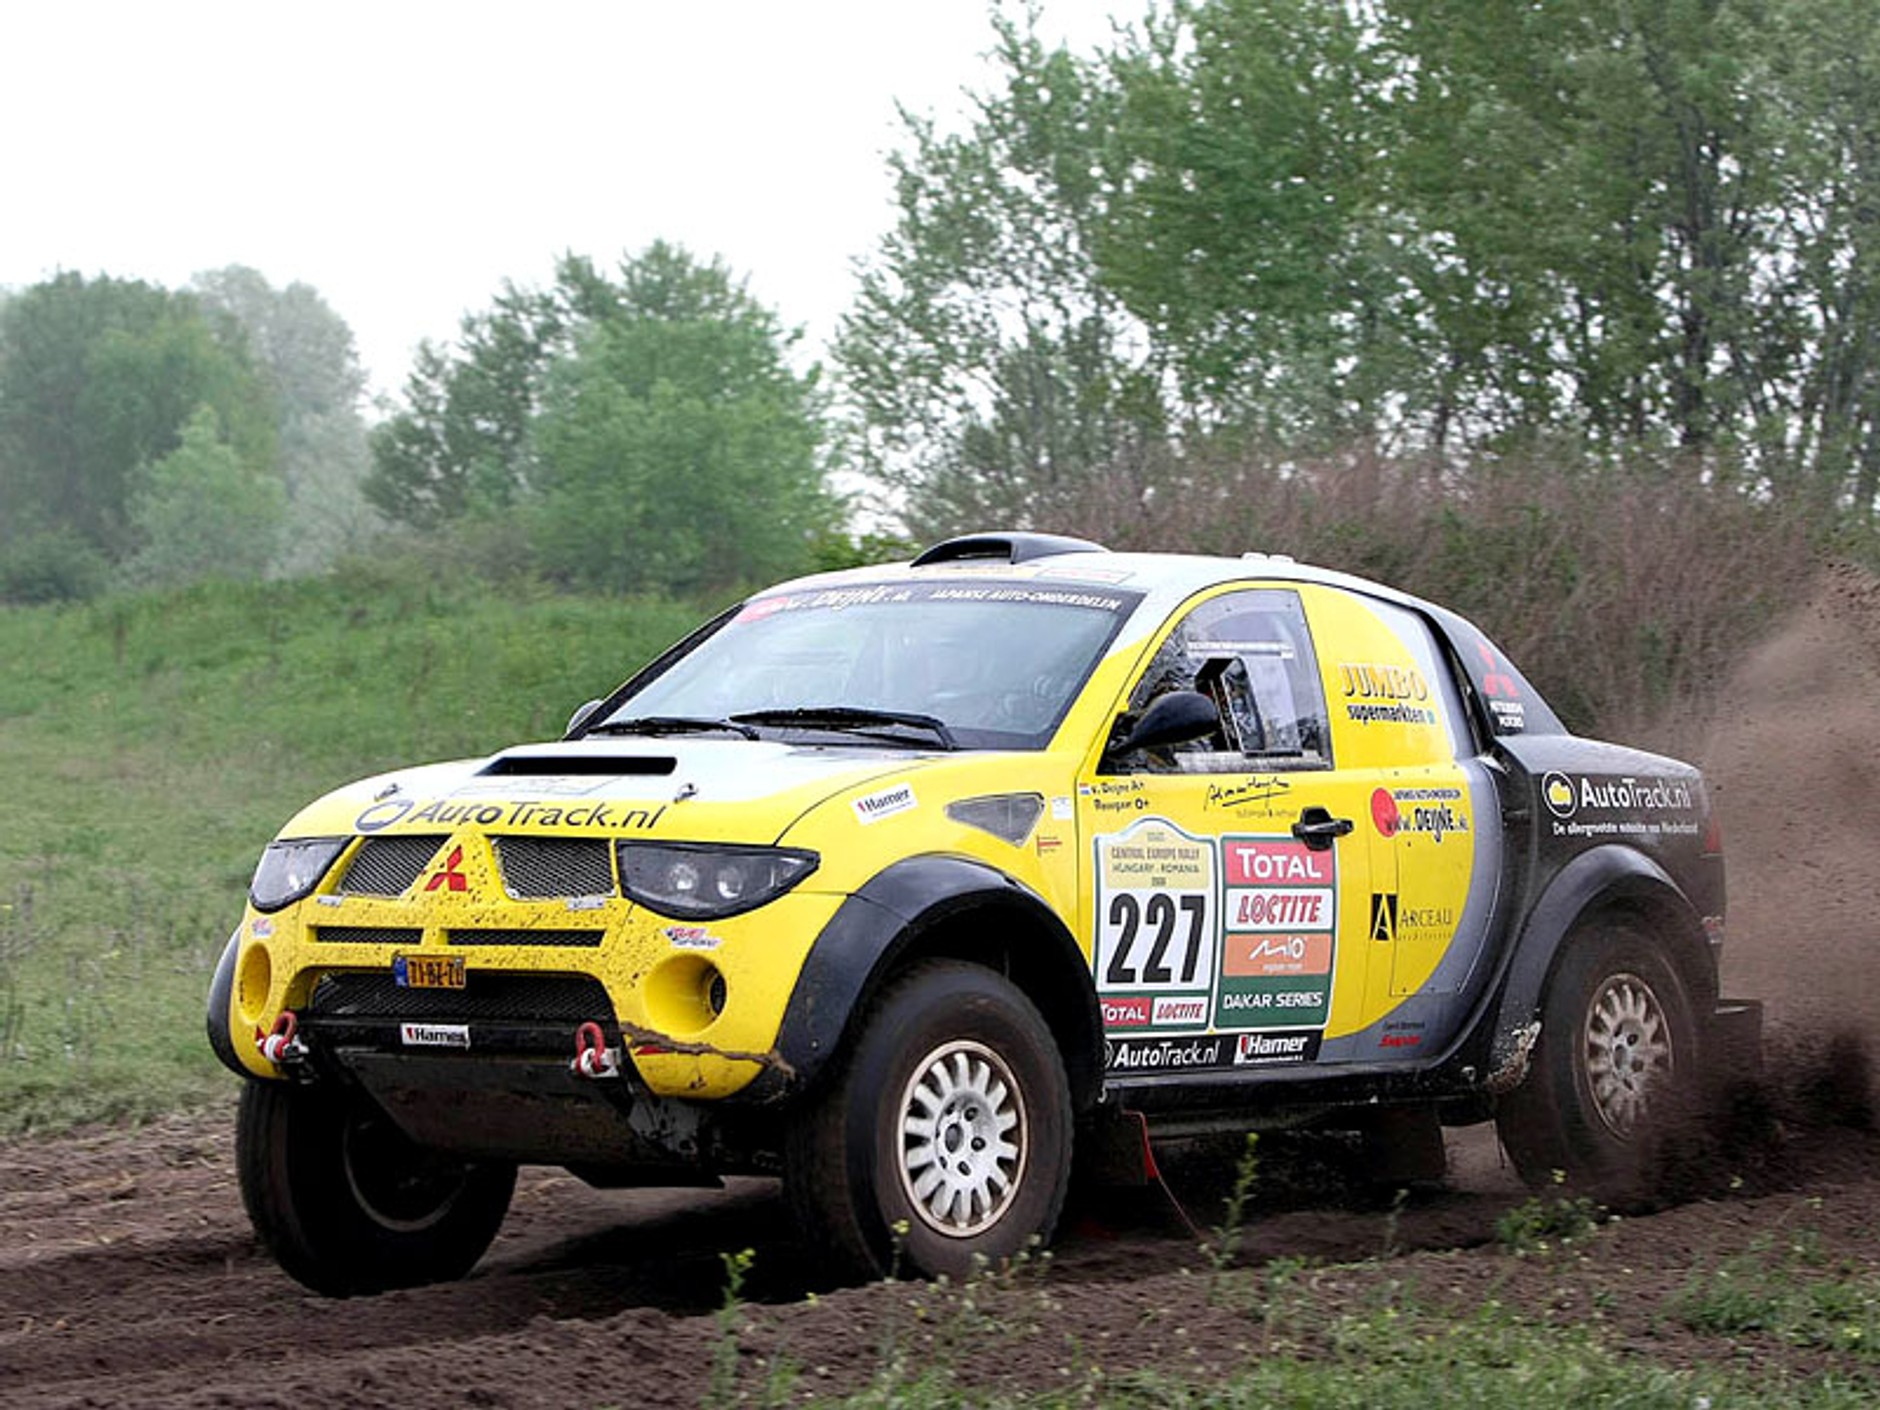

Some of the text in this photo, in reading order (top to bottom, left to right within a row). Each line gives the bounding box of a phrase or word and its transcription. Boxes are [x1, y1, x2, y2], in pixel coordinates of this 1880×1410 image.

[1340, 665, 1428, 701] JUMBO
[866, 788, 910, 813] Hamer
[1581, 778, 1692, 808] AutoTrack.nl
[407, 801, 667, 830] AutoTrack.nl
[1237, 895, 1322, 924] LOCTITE
[1106, 893, 1206, 984] 227
[1156, 1003, 1204, 1020] LOCTITE
[1222, 991, 1324, 1010] DAKAR SERIES
[1113, 1040, 1221, 1068] AutoTrack.nl
[1247, 1035, 1308, 1054] Hamer
